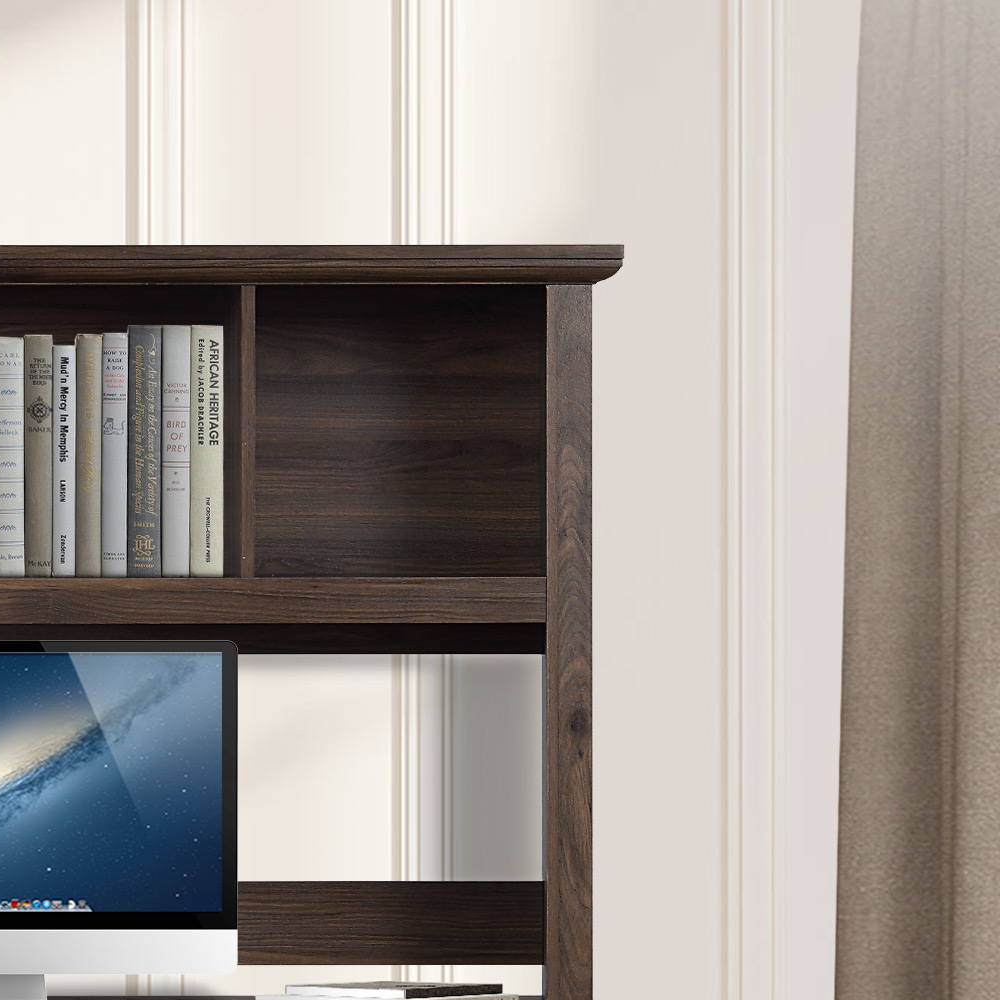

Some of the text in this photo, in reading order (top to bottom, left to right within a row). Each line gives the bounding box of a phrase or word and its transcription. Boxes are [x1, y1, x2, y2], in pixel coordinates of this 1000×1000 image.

[133, 345, 145, 388] Complexion
[197, 365, 204, 374] by
[135, 390, 144, 406] and
[145, 381, 157, 402] Essay
[209, 339, 219, 446] AFRICAN HERITAGE
[58, 356, 69, 462] Mud'n Mercy In Memphis
[132, 407, 144, 431] Figure
[148, 415, 157, 426] the
[135, 444, 144, 455] the
[135, 458, 144, 489] Human
[148, 463, 157, 474] the
[145, 476, 157, 505] Variety
